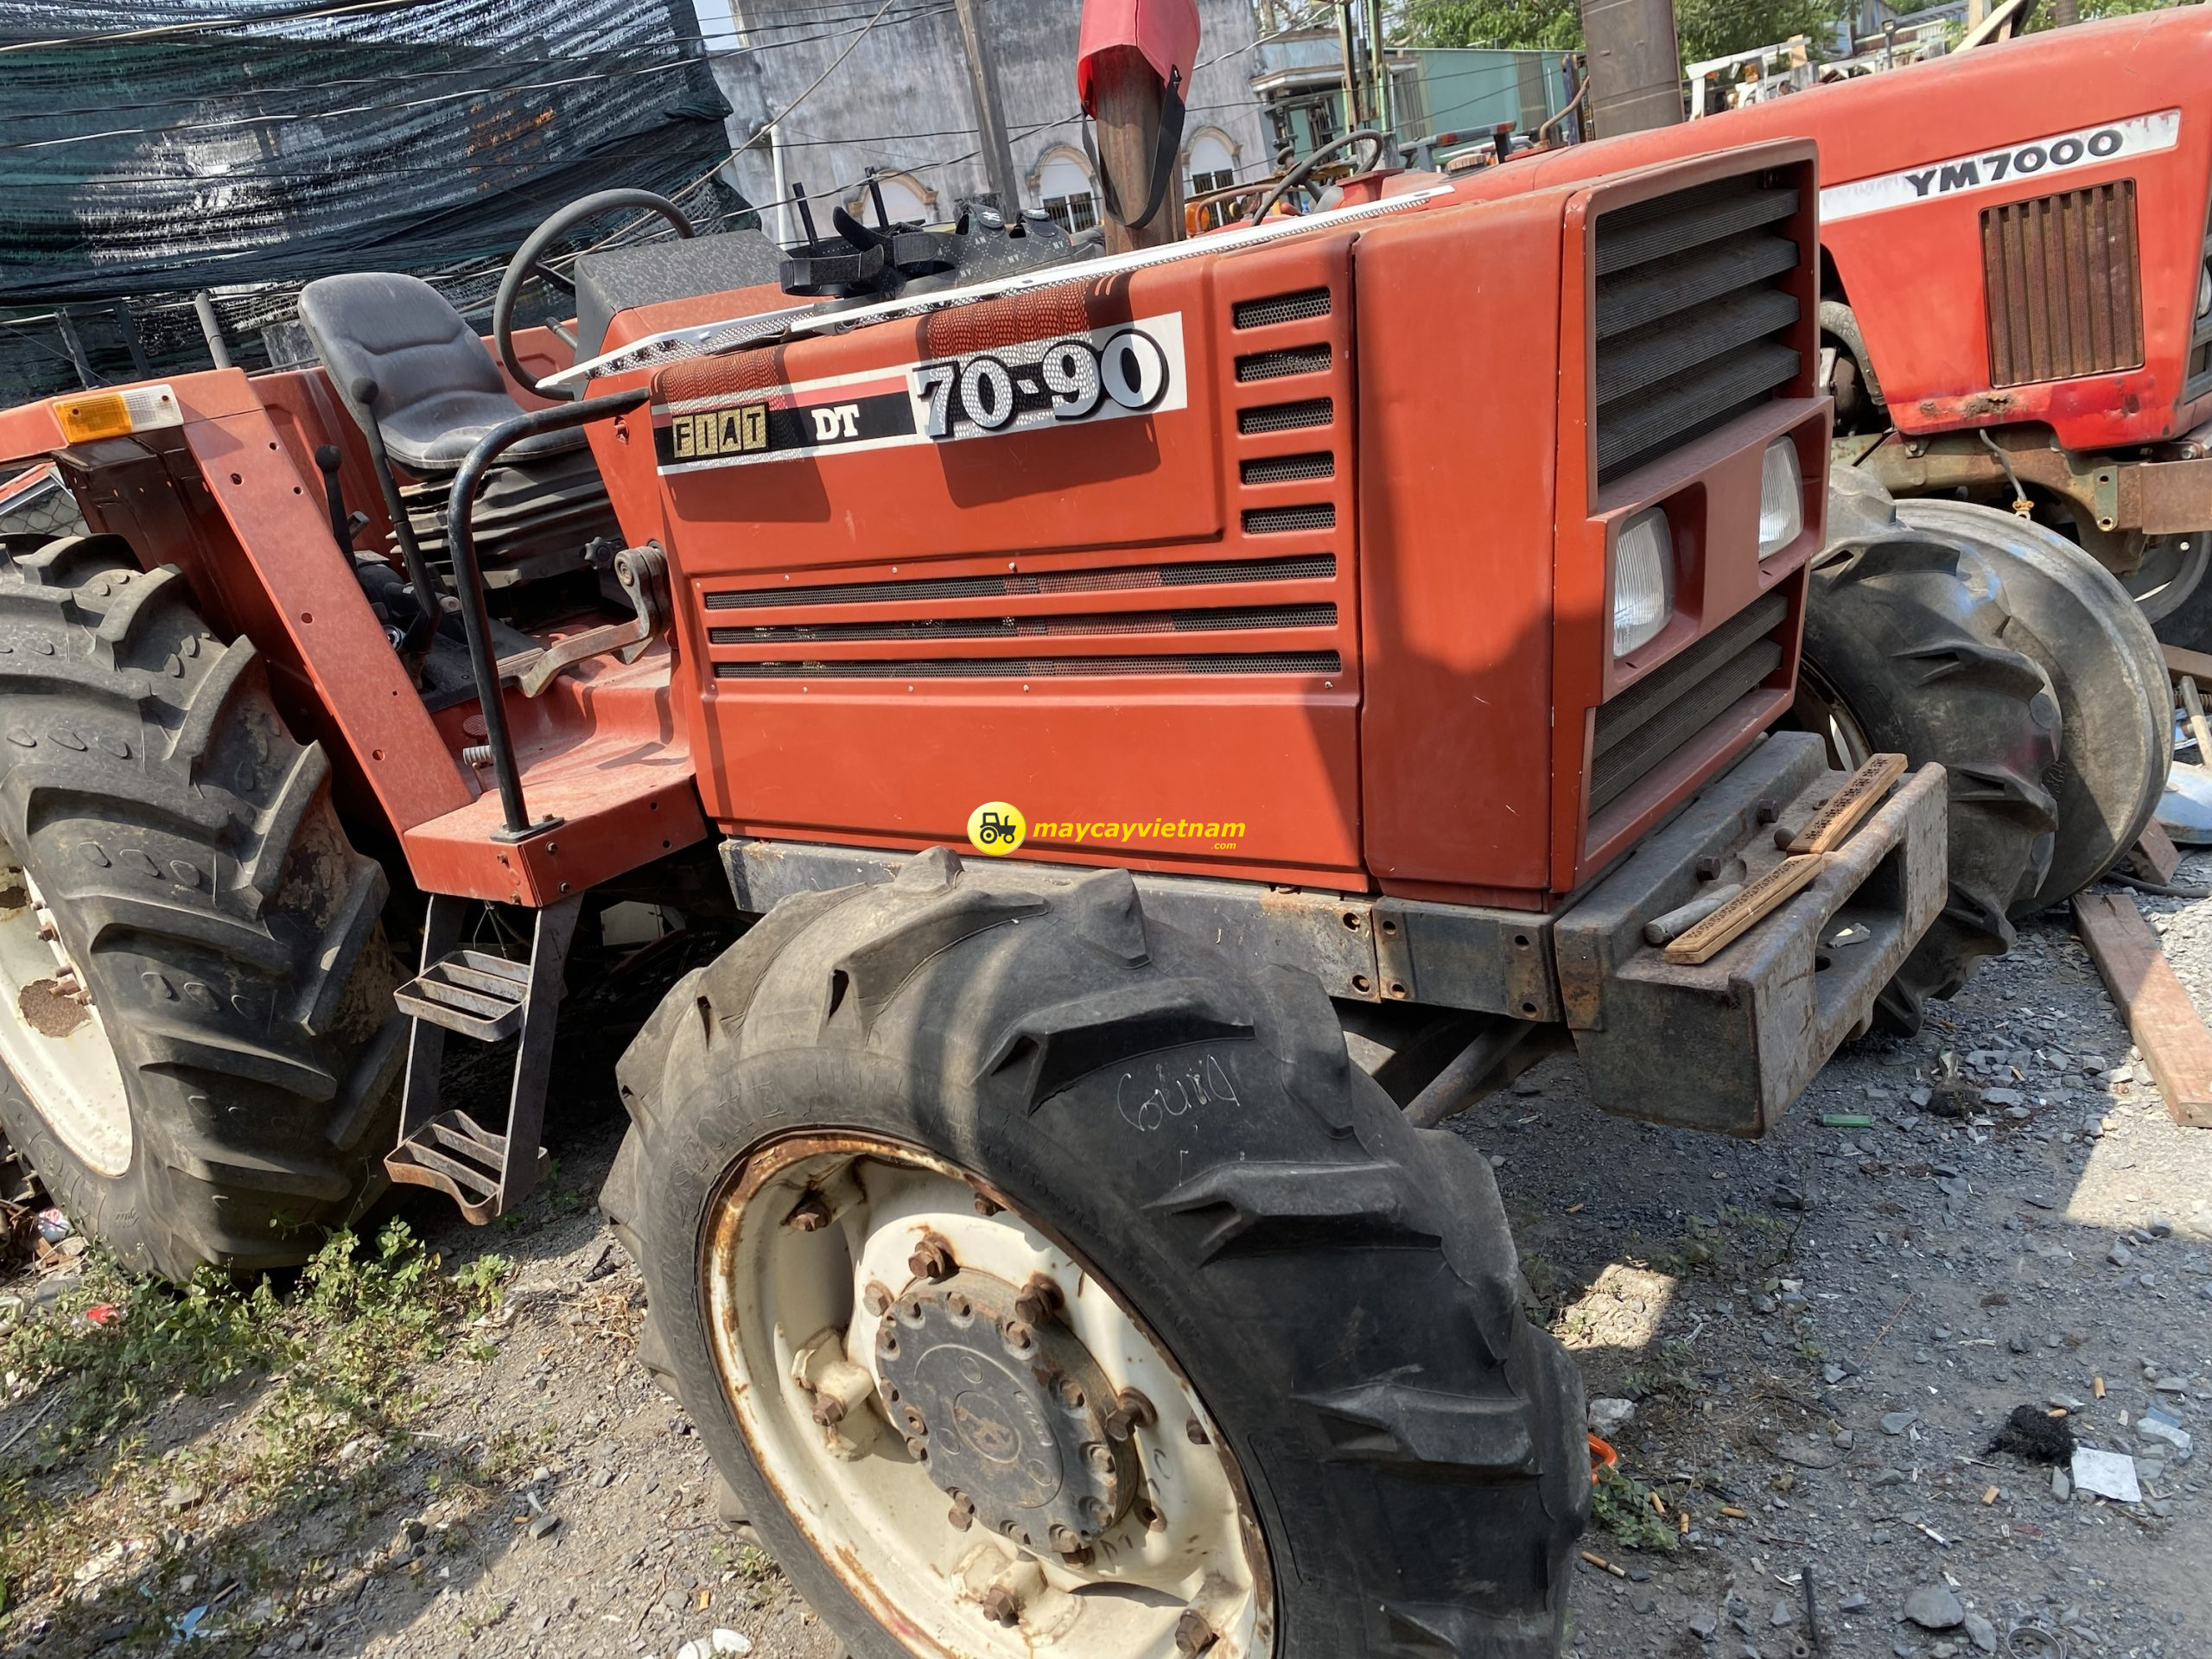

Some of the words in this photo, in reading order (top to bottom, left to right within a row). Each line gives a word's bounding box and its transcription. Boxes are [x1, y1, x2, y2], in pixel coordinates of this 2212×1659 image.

[1905, 130, 2123, 196] YM7000
[674, 406, 767, 459] FIAT
[811, 404, 861, 442] DT
[912, 328, 1169, 439] 70-90
